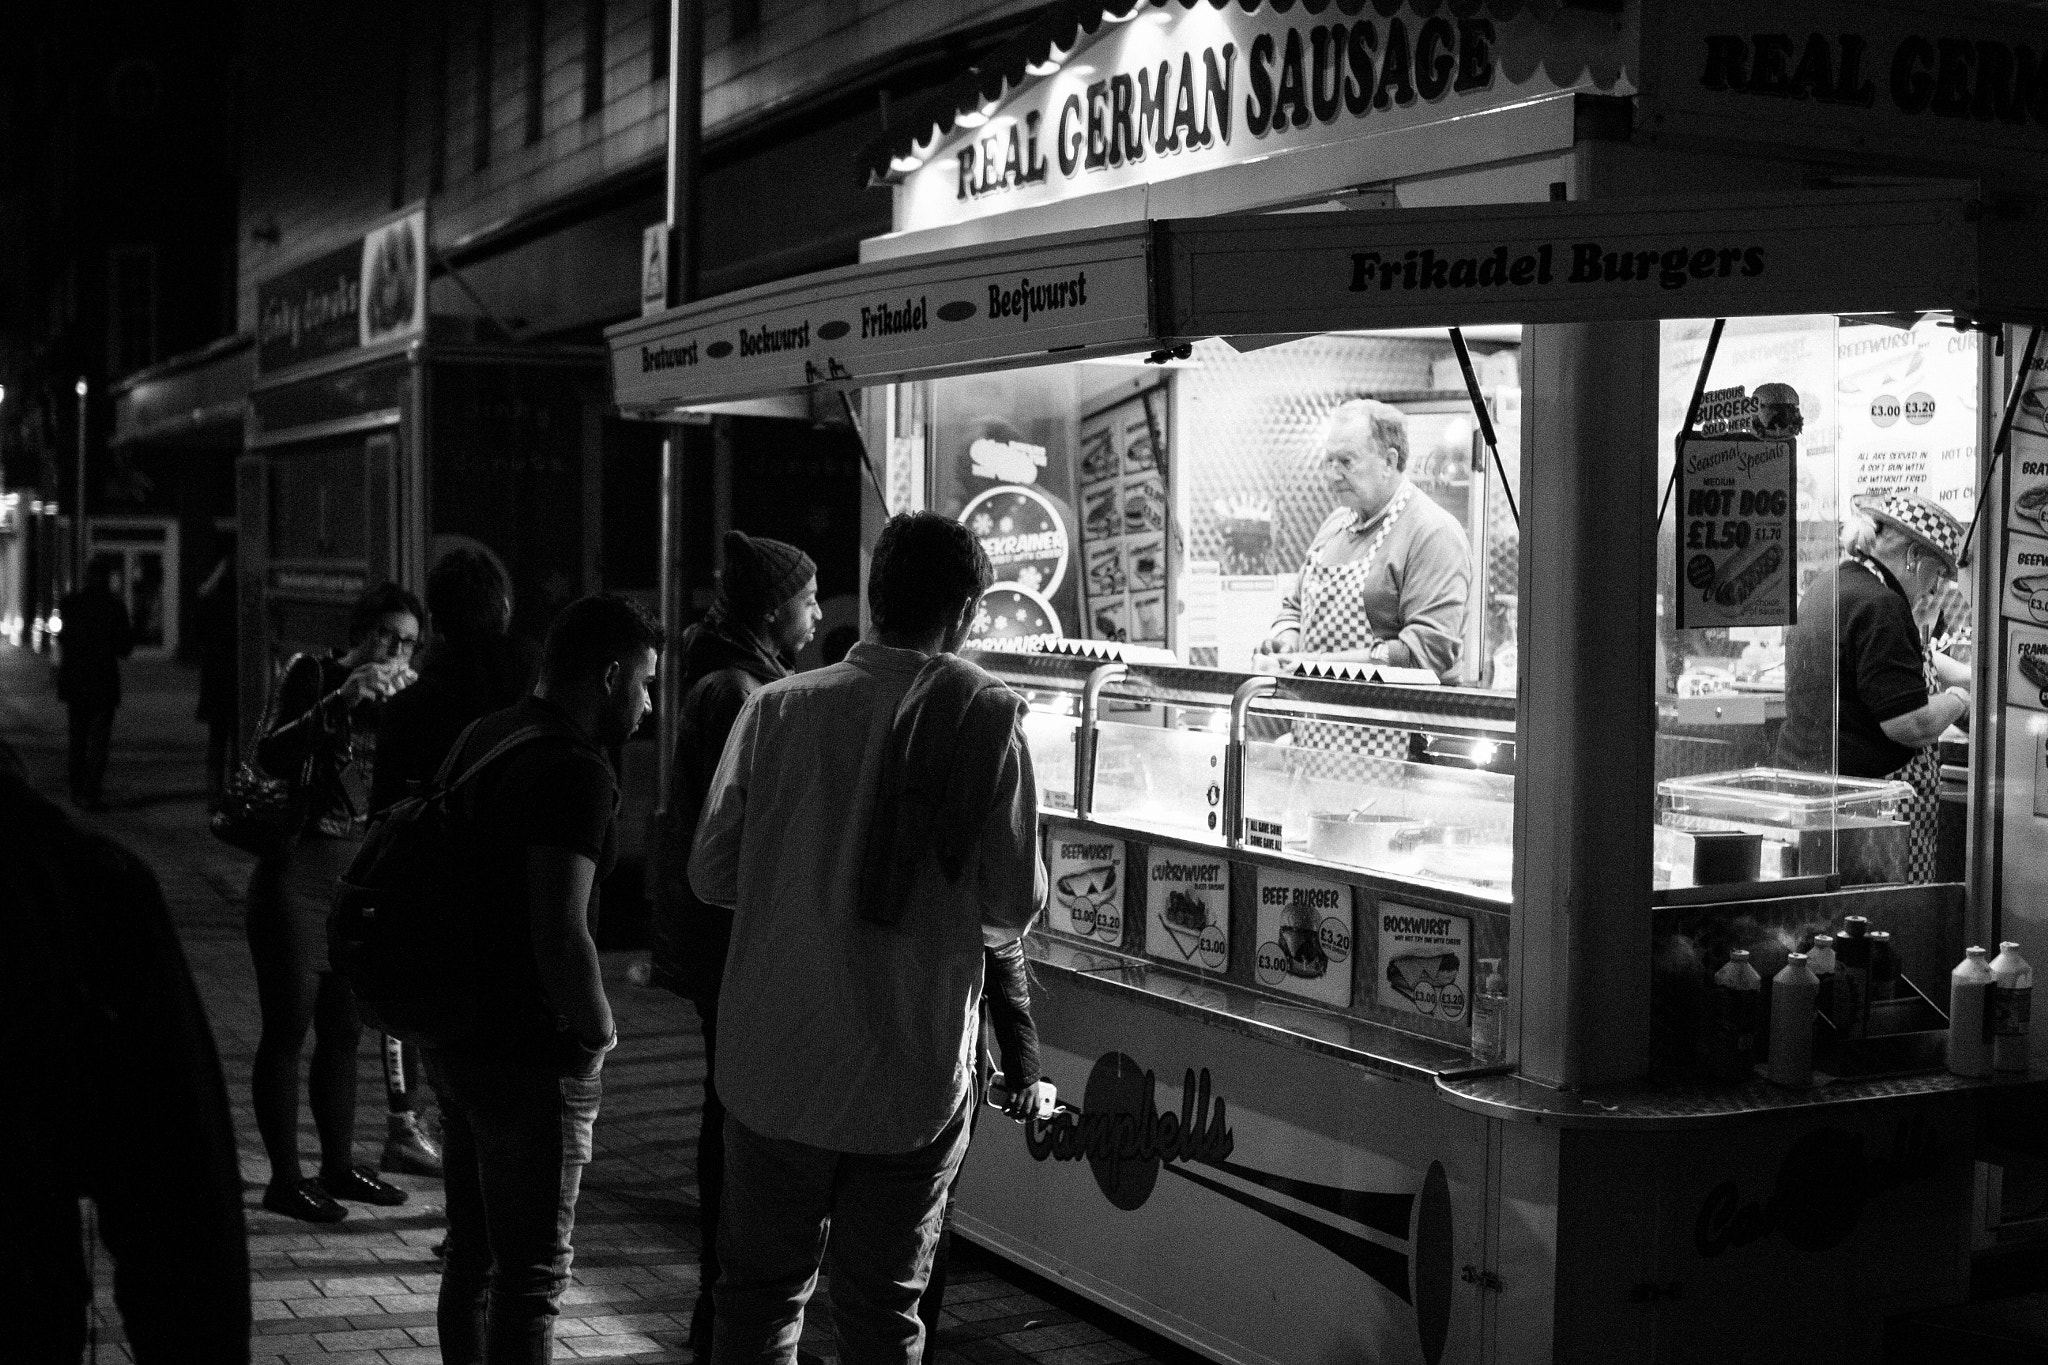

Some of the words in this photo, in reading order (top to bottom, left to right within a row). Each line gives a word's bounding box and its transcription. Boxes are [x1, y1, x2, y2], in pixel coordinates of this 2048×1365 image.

[1700, 33, 1876, 108] REAL
[956, 109, 1048, 200] REAL
[1057, 41, 1238, 178] GERMAN
[1245, 14, 1498, 138] SAUSAGE
[1349, 243, 1554, 293] Frikadel
[1568, 242, 1765, 291] Burgers
[641, 340, 699, 373] Bratwurst
[738, 319, 811, 358] Bockwurst
[860, 296, 928, 339] Frikadel
[988, 271, 1088, 323] Beefwurst
[1695, 396, 1760, 423] BURGERS
[1870, 405, 1901, 417] £3.00
[1905, 401, 1936, 414] £3.20
[1703, 422, 1726, 436] SOLD
[1729, 416, 1751, 431] HERE
[1686, 441, 1740, 475] Seasonal
[1737, 441, 1785, 479] Specials
[1857, 452, 1869, 461] ALL
[1872, 452, 1887, 461] ARE
[1889, 451, 1918, 460] SERVED
[1919, 451, 1929, 460] IN
[1941, 448, 1962, 460] HOT
[1860, 463, 1866, 472] A
[1868, 463, 1885, 472] SOFT
[1888, 463, 1904, 472] BUN
[1905, 462, 1926, 472] WITH
[1703, 477, 1736, 487] MEDIUM
[1857, 475, 1868, 483] OR
[1870, 474, 1903, 483] WITHOUT
[1905, 474, 1928, 483] FRIED
[1687, 488, 1736, 517] HOT
[1738, 488, 1788, 517] DOG
[1939, 488, 1960, 502] HOT
[1686, 520, 1752, 550] £1.50
[1755, 528, 1782, 541] £1.70
[1250, 820, 1258, 832] ALL
[1259, 821, 1270, 834] GAVE
[1061, 843, 1114, 861] BEEFWURST
[1151, 860, 1220, 882] CURRYWURST
[1262, 886, 1290, 906] BEEF
[1292, 887, 1339, 909] BURGER
[1072, 908, 1095, 923] £3.00
[1097, 913, 1120, 929] £3.20
[1383, 915, 1452, 936] BOCKWURST
[1200, 938, 1225, 954] £3.00
[1321, 927, 1350, 950] £3.20
[1258, 955, 1287, 972] £3.00
[1415, 991, 1436, 1004] £3.00
[1441, 993, 1463, 1006] £3.20
[1025, 1066, 1235, 1194] Campbells
